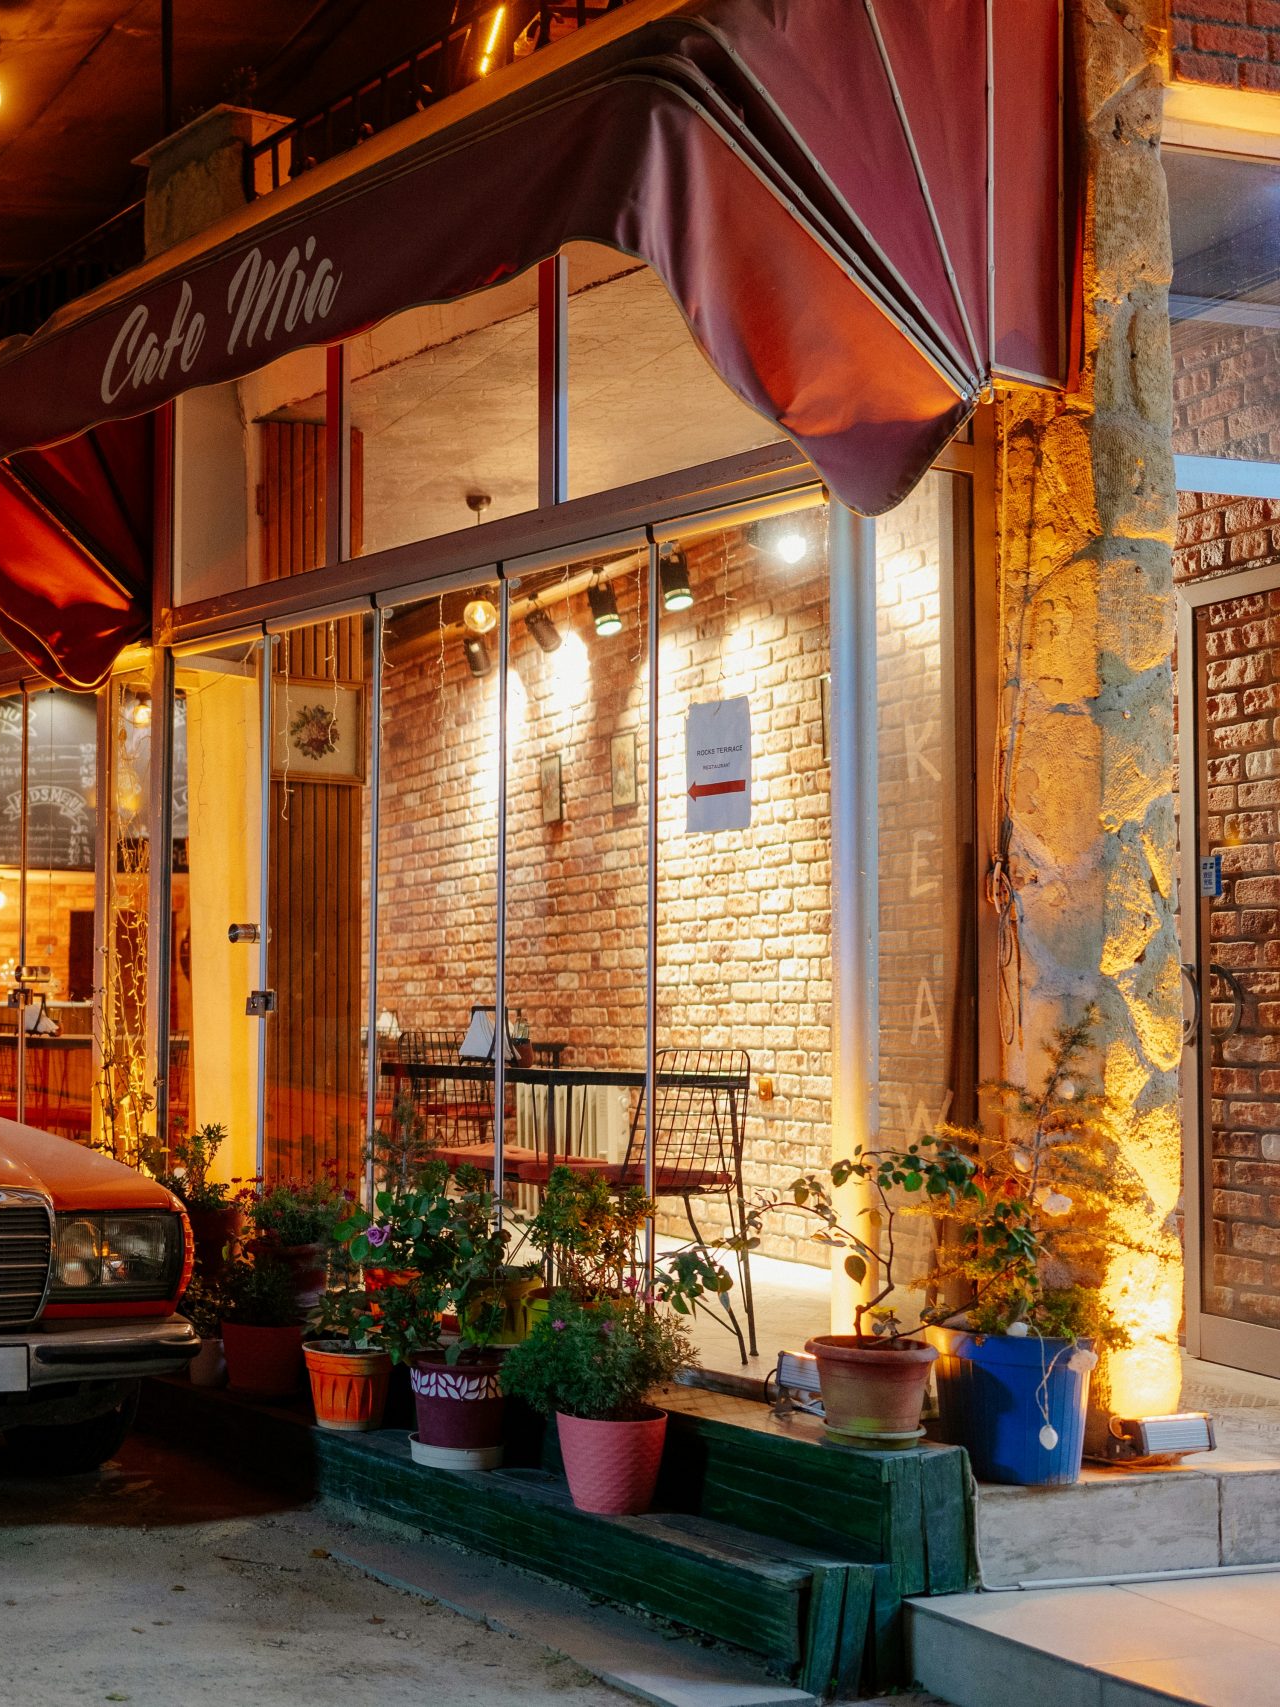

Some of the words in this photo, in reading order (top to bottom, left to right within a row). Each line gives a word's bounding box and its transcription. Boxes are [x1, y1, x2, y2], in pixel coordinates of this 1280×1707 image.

[101, 280, 207, 404] Cafe
[227, 235, 343, 355] Mia
[716, 744, 743, 754] TERRACE
[702, 762, 731, 771] RESTAURANT
[14, 788, 49, 812] KDS
